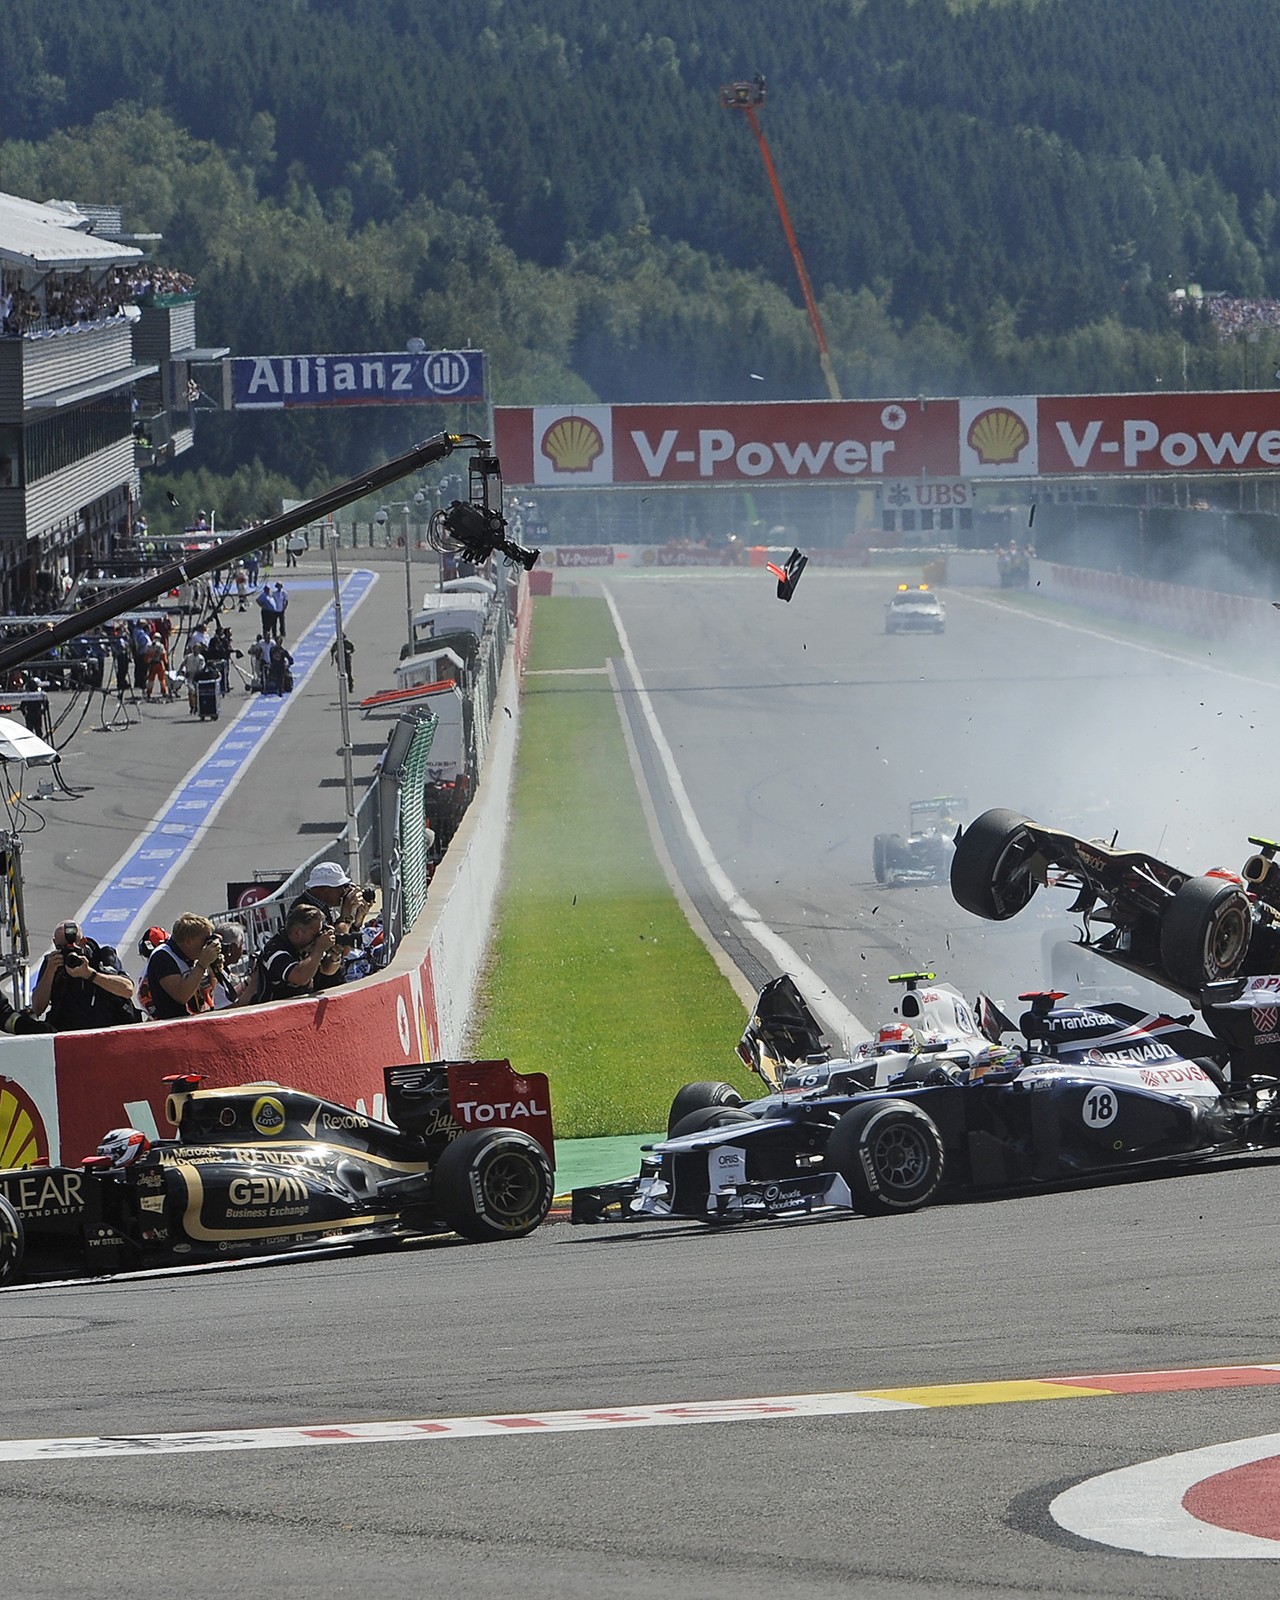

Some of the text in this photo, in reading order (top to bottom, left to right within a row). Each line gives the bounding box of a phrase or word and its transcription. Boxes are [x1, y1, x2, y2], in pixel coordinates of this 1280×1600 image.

[248, 358, 413, 394] Allianz
[630, 429, 895, 477] V-Power
[915, 483, 967, 505] UBS
[1061, 1009, 1115, 1030] randstad
[1254, 1032, 1280, 1045] PDVSA
[1102, 1043, 1178, 1064] RENAULT
[797, 1074, 819, 1086] 15
[1158, 1066, 1210, 1085] PDVSA
[456, 1099, 548, 1124] TOTAL
[1087, 1094, 1113, 1121] 18
[257, 1114, 281, 1126] LOTUS
[322, 1112, 369, 1130] Rexona
[172, 1146, 221, 1158] Microsoft
[175, 1155, 223, 1166] Dynamics
[718, 1154, 739, 1165] ORIS
[0, 1173, 86, 1211] LEAR
[226, 1205, 310, 1219] Business Exchange
[101, 1237, 124, 1246] STEEL
[299, 1403, 797, 1440] UBS
